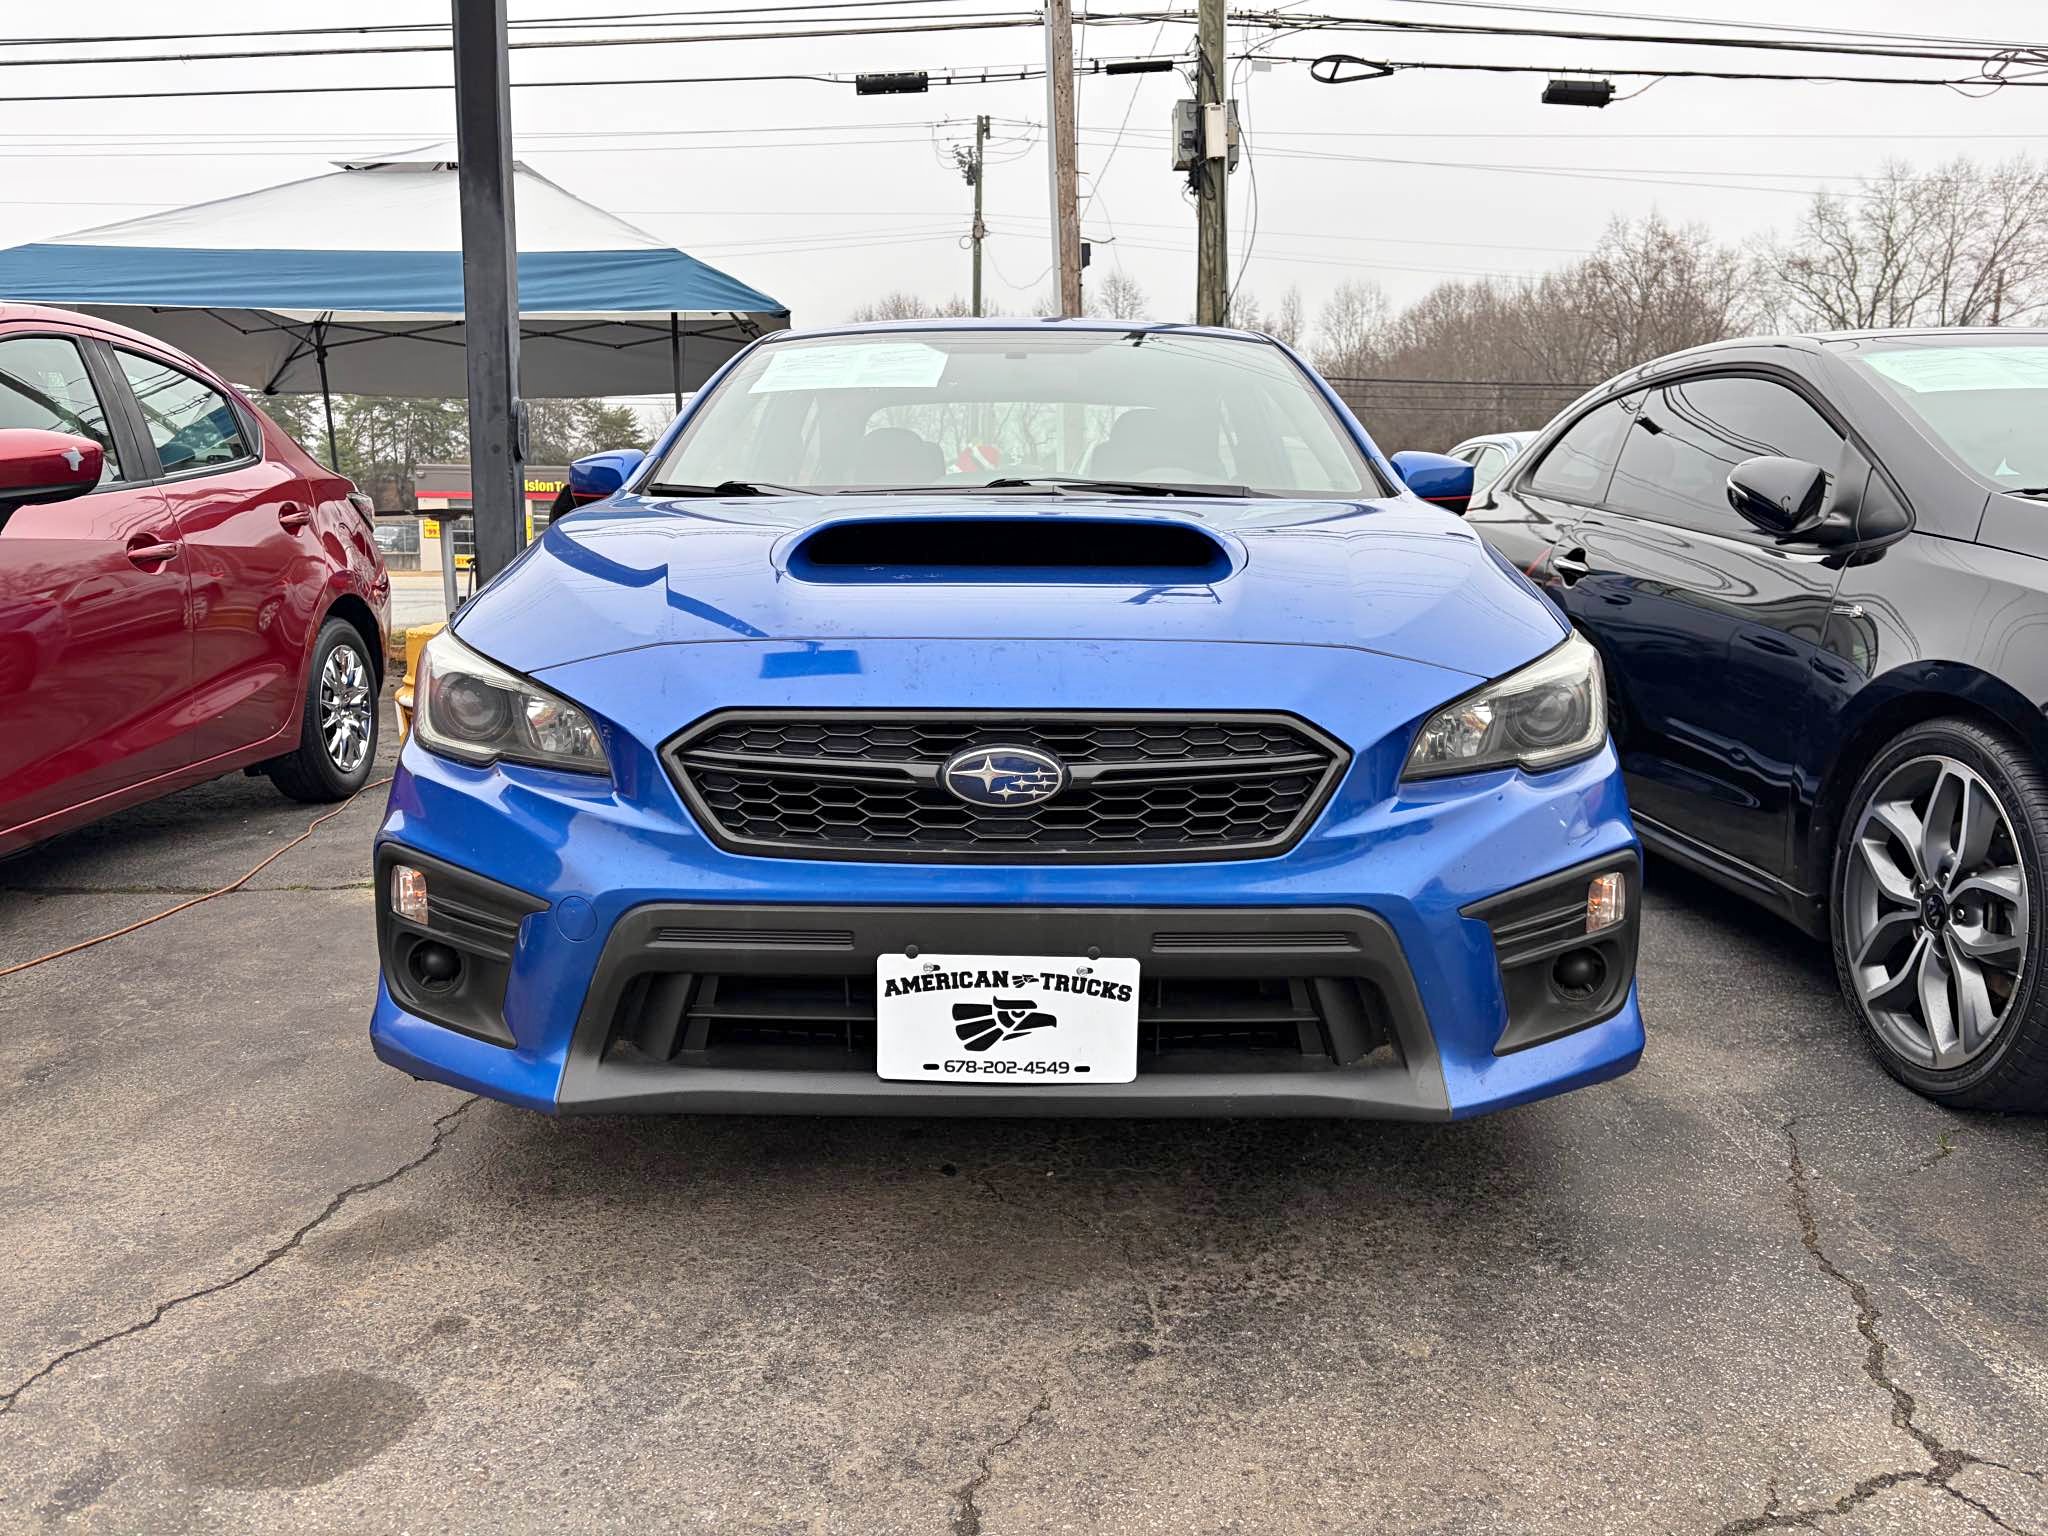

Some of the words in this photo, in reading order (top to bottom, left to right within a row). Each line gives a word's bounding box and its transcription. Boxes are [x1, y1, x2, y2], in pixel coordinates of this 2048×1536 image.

[884, 970, 1009, 998] AMERICAN
[1040, 972, 1133, 1002] TRUCKS
[944, 1059, 1070, 1075] 678-202-4549
